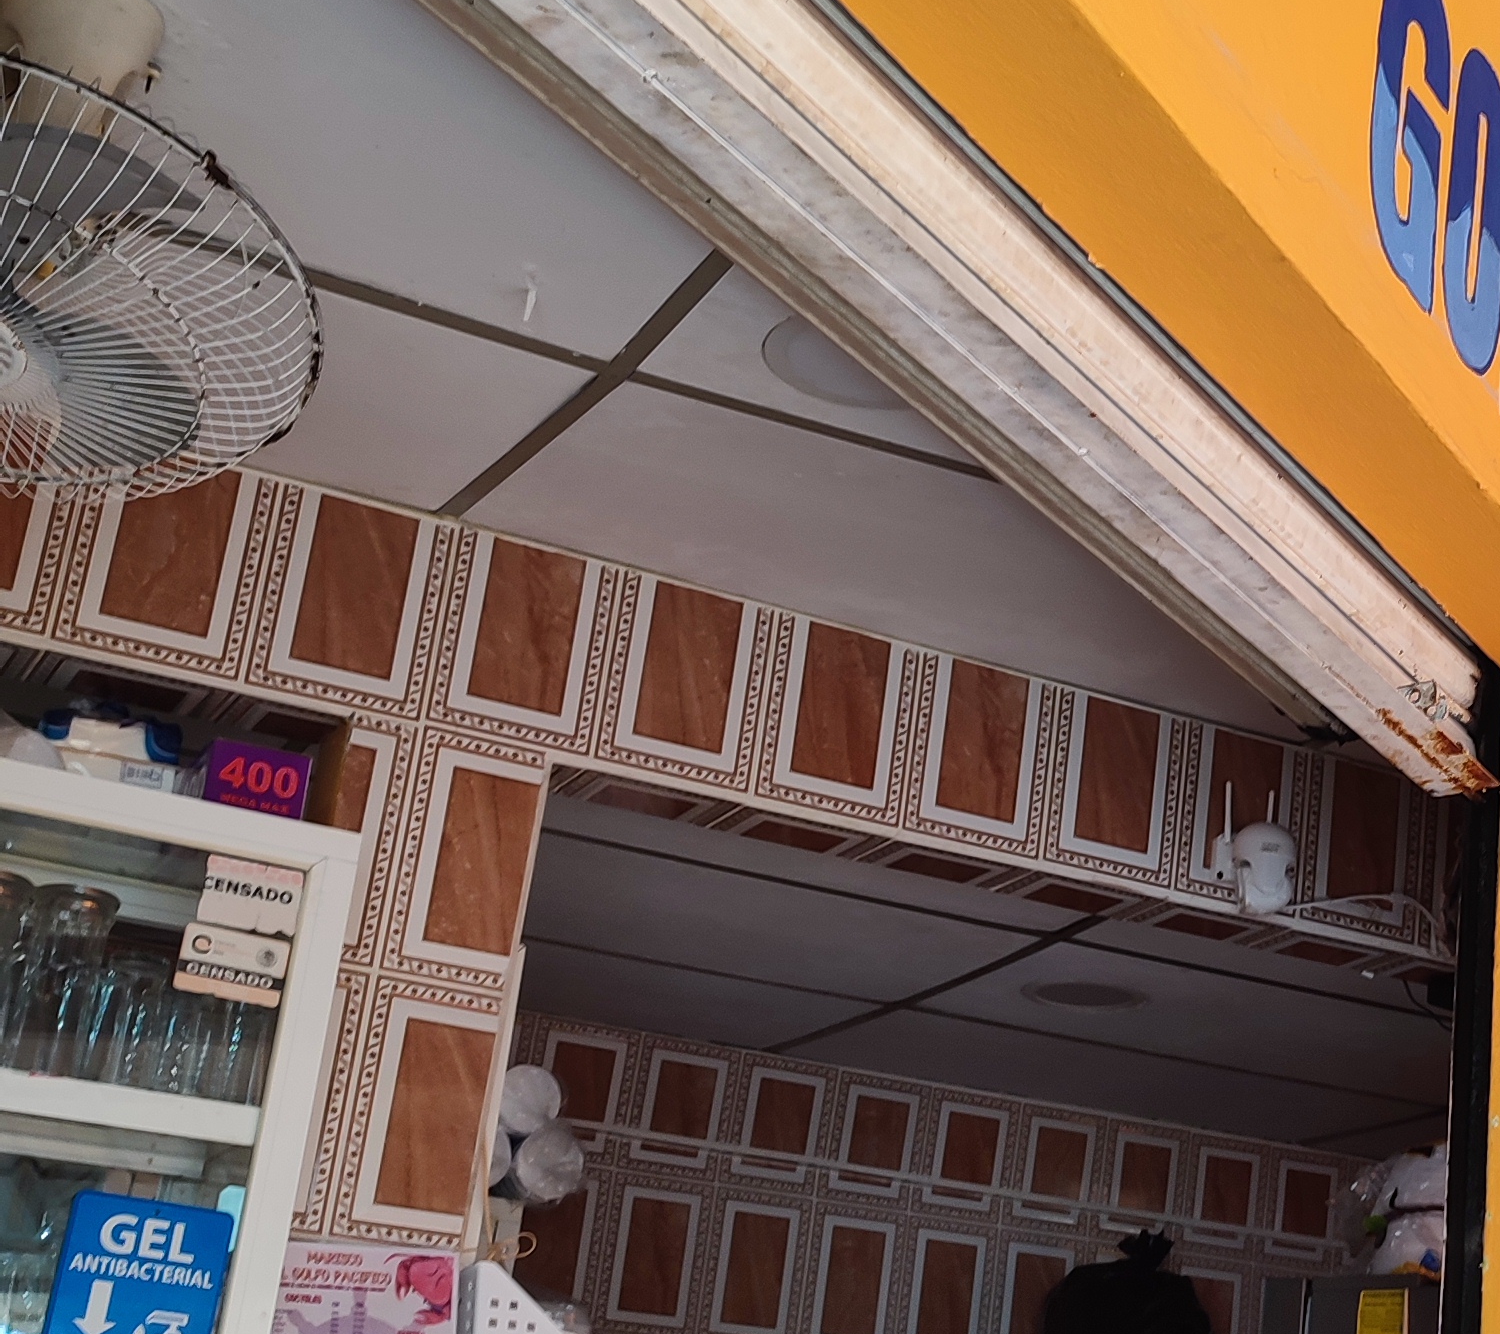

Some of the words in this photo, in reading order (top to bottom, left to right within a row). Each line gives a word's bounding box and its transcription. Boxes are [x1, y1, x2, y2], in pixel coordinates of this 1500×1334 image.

[219, 756, 300, 799] 400
[204, 876, 293, 905] CENSADO
[186, 961, 274, 990] CENSADO
[100, 1213, 195, 1265] GEL
[69, 1252, 214, 1290] ANTIBACTERIAL
